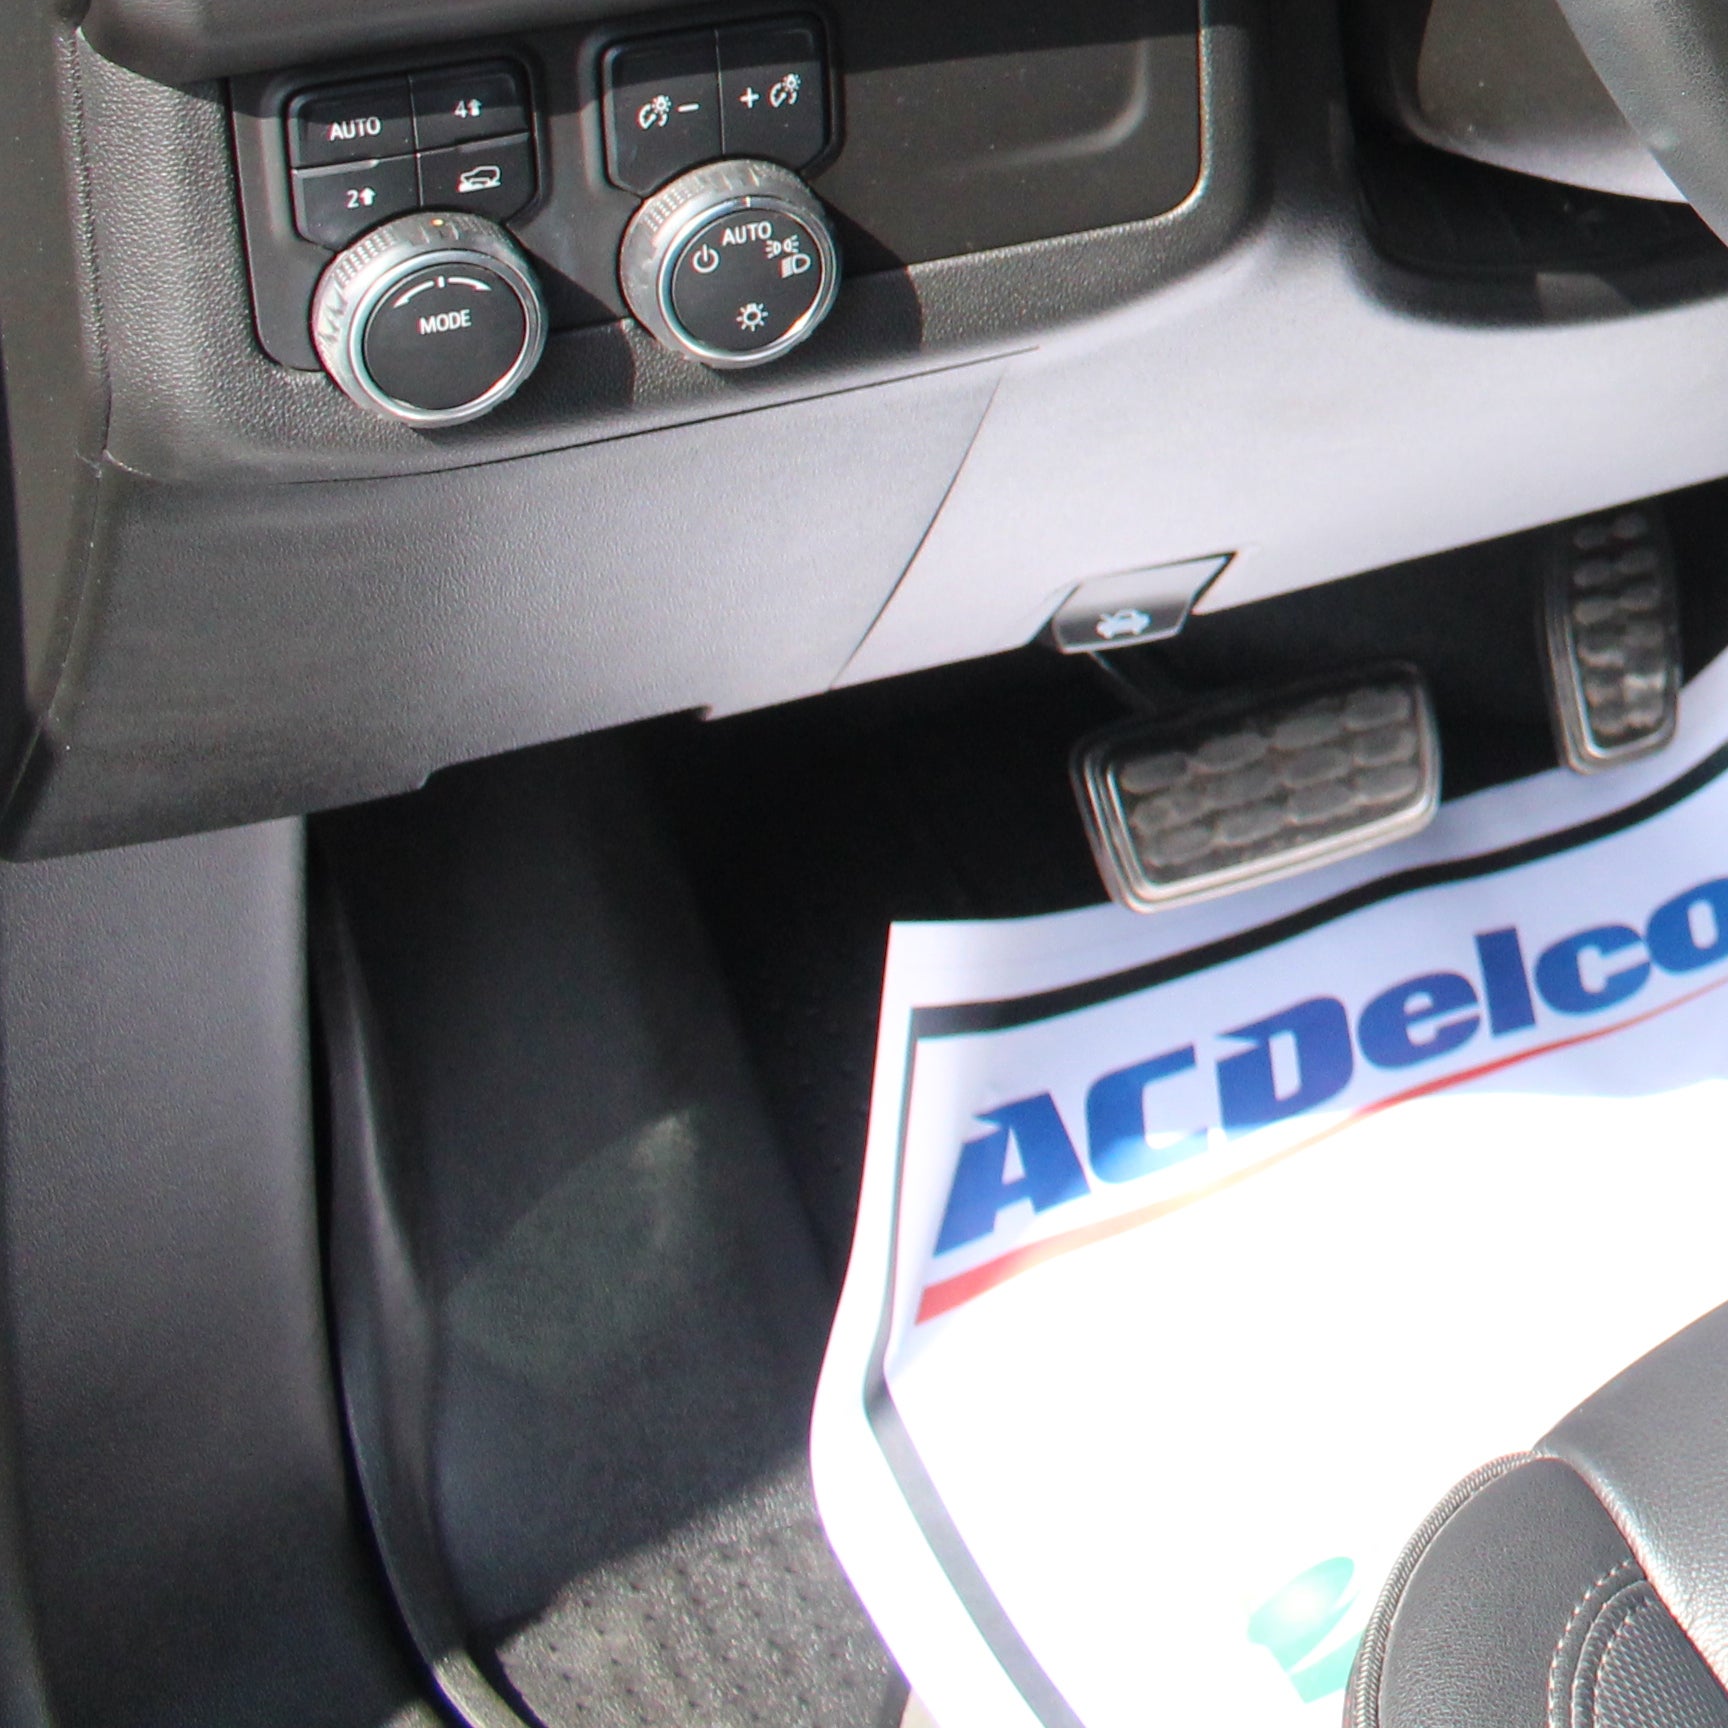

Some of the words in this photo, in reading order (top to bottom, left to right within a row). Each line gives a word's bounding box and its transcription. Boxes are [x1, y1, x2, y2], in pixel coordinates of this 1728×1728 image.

[329, 117, 382, 141] AUTO
[722, 221, 773, 247] AUTO
[420, 309, 472, 334] MODE
